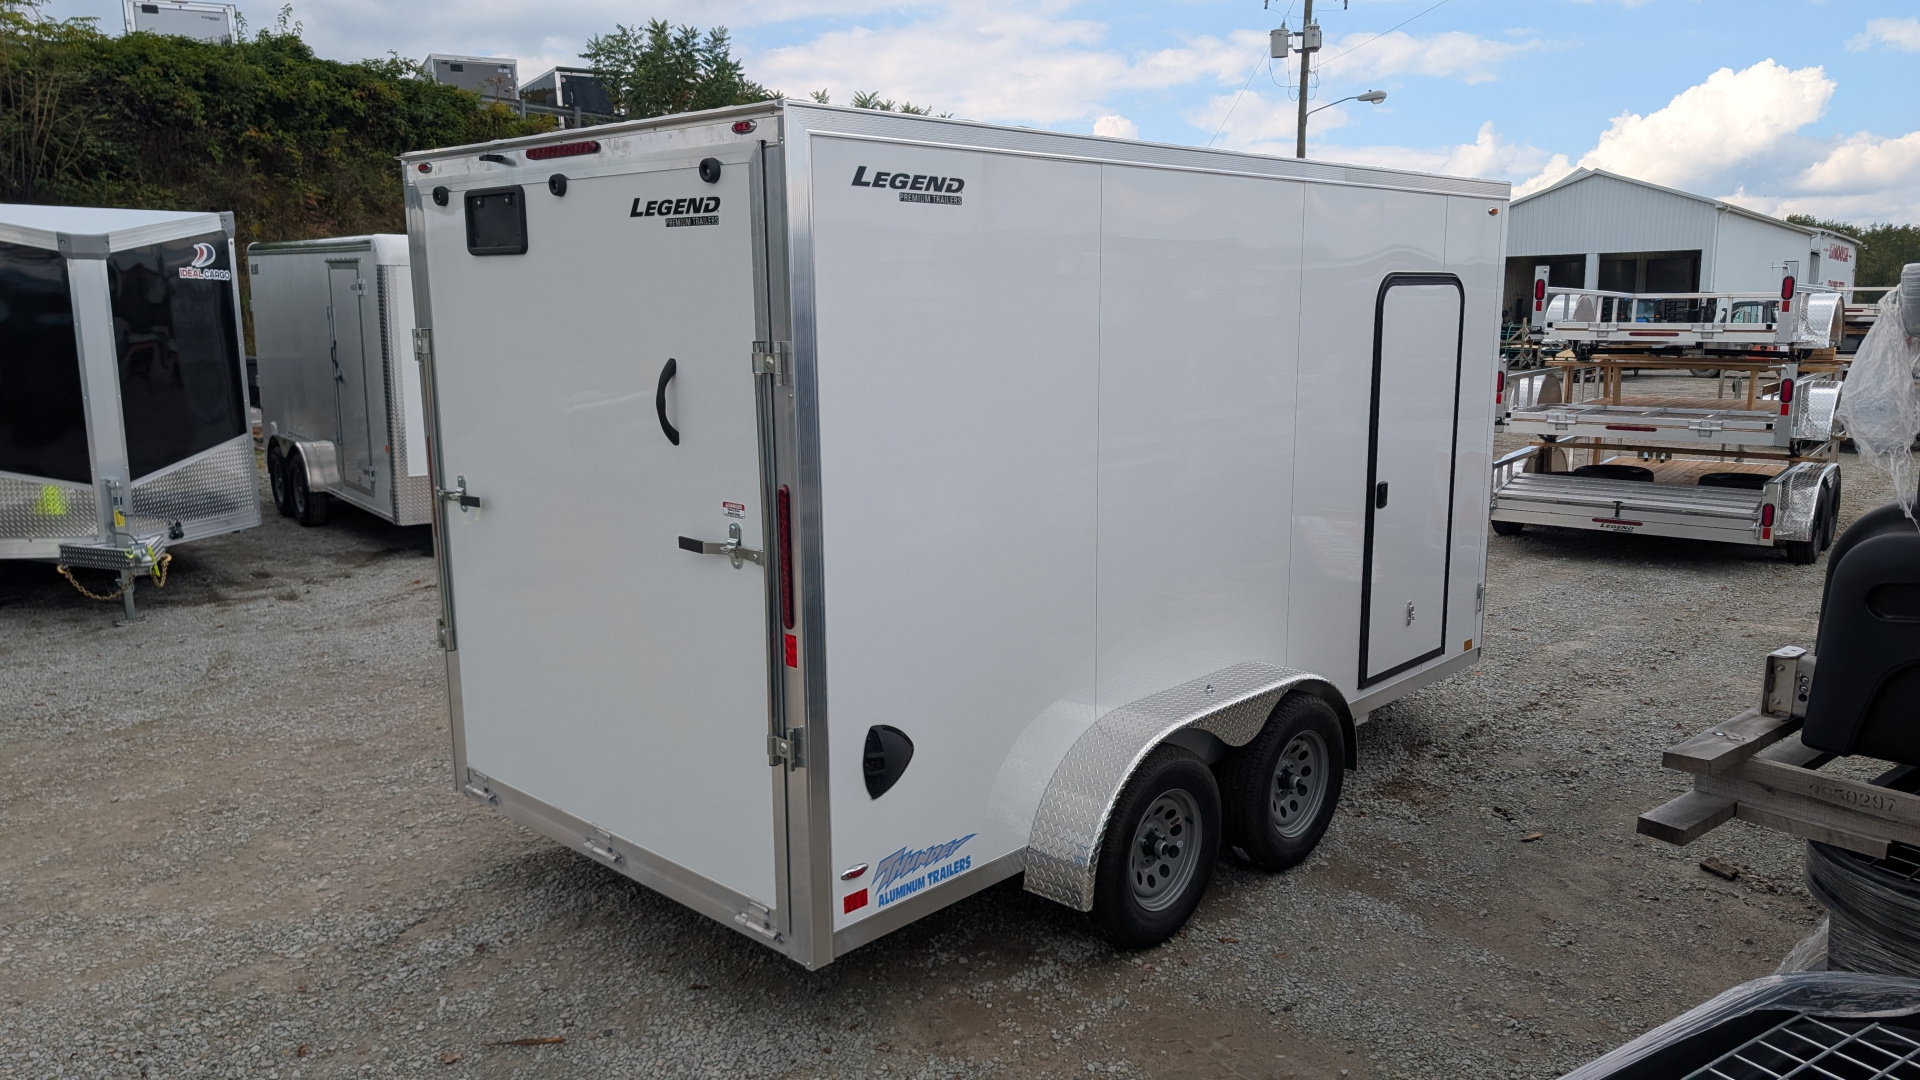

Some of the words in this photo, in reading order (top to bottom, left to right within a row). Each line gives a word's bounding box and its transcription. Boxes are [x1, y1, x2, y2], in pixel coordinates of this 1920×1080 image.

[852, 165, 965, 194] LEGEND
[630, 196, 720, 217] LEGEND
[900, 193, 931, 203] PREMIUM
[932, 195, 962, 205] TRAILERS
[665, 217, 691, 227] PREMIUM
[692, 215, 719, 226] TRAILERS
[203, 268, 231, 281] CARGO
[871, 833, 978, 897] THUNDER
[878, 876, 925, 908] ALUMINUM
[927, 854, 971, 886] TRAILERS
